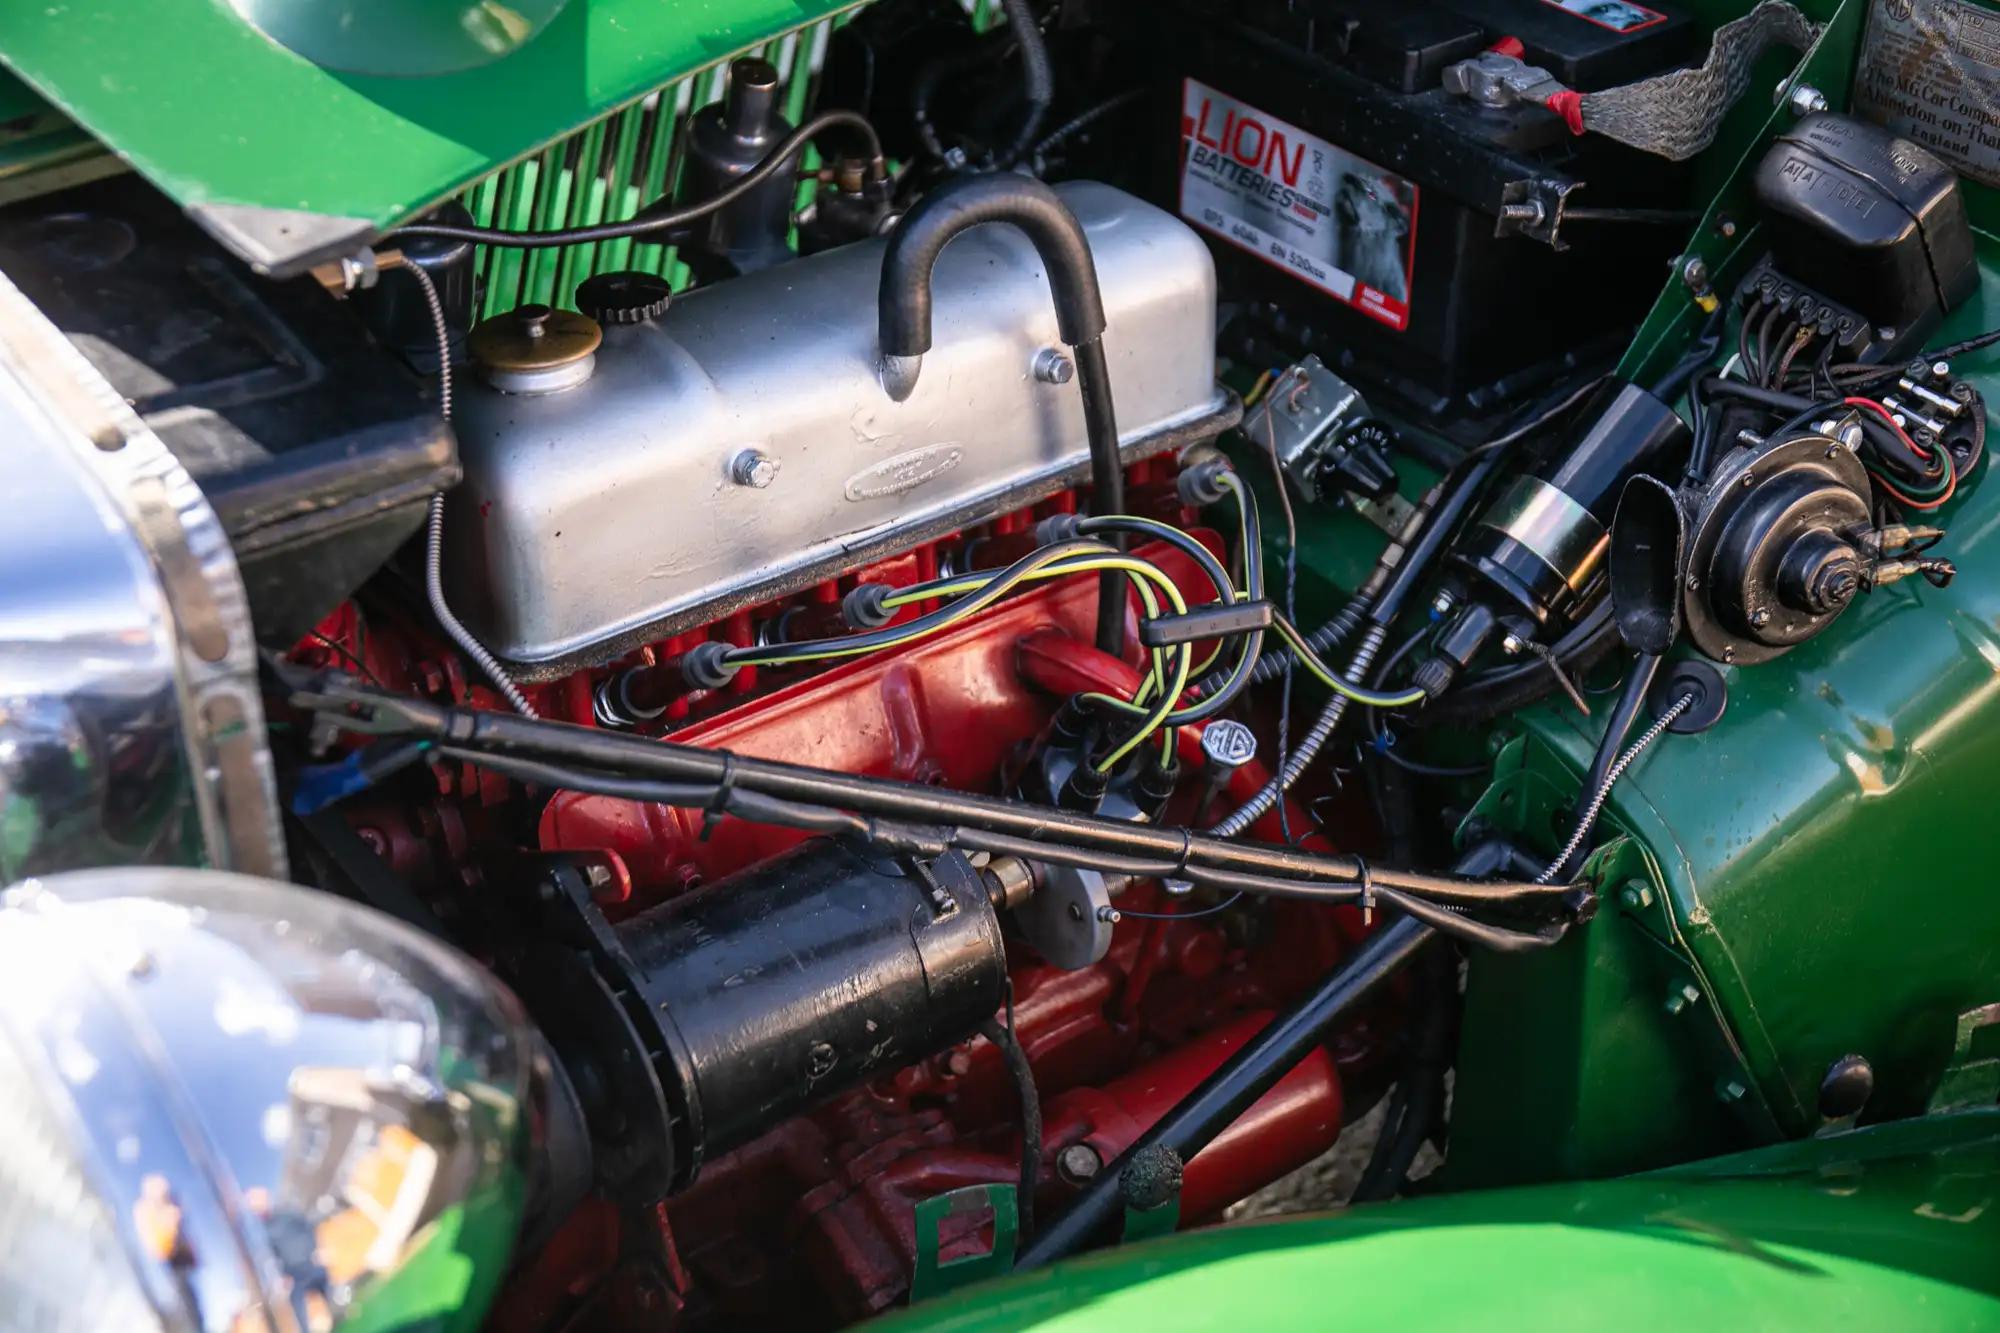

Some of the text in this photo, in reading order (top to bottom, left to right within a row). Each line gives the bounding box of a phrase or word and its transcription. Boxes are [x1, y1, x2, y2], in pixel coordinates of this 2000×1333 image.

[1950, 96, 2000, 127] Compa
[1196, 97, 1306, 188] LION
[1911, 123, 1970, 156] England
[1192, 144, 1296, 208] BATTERIES
[1210, 726, 1252, 758] MG
